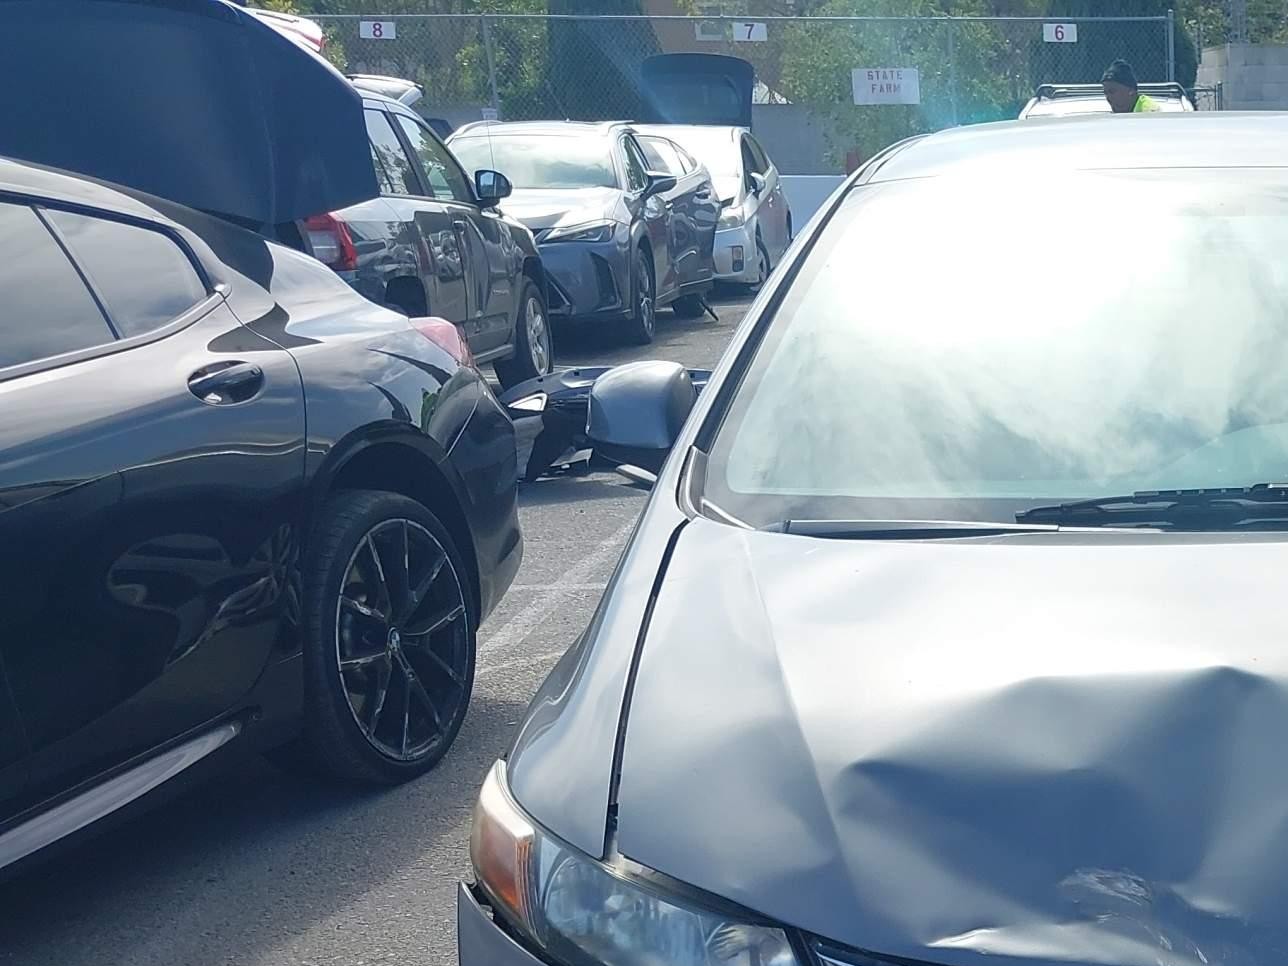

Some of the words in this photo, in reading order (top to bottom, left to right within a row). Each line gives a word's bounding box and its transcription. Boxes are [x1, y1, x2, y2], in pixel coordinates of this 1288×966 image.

[372, 22, 383, 38] 8
[744, 23, 755, 40] 7
[1055, 24, 1064, 41] 6
[867, 70, 903, 81] STATE
[871, 83, 901, 94] FARM
